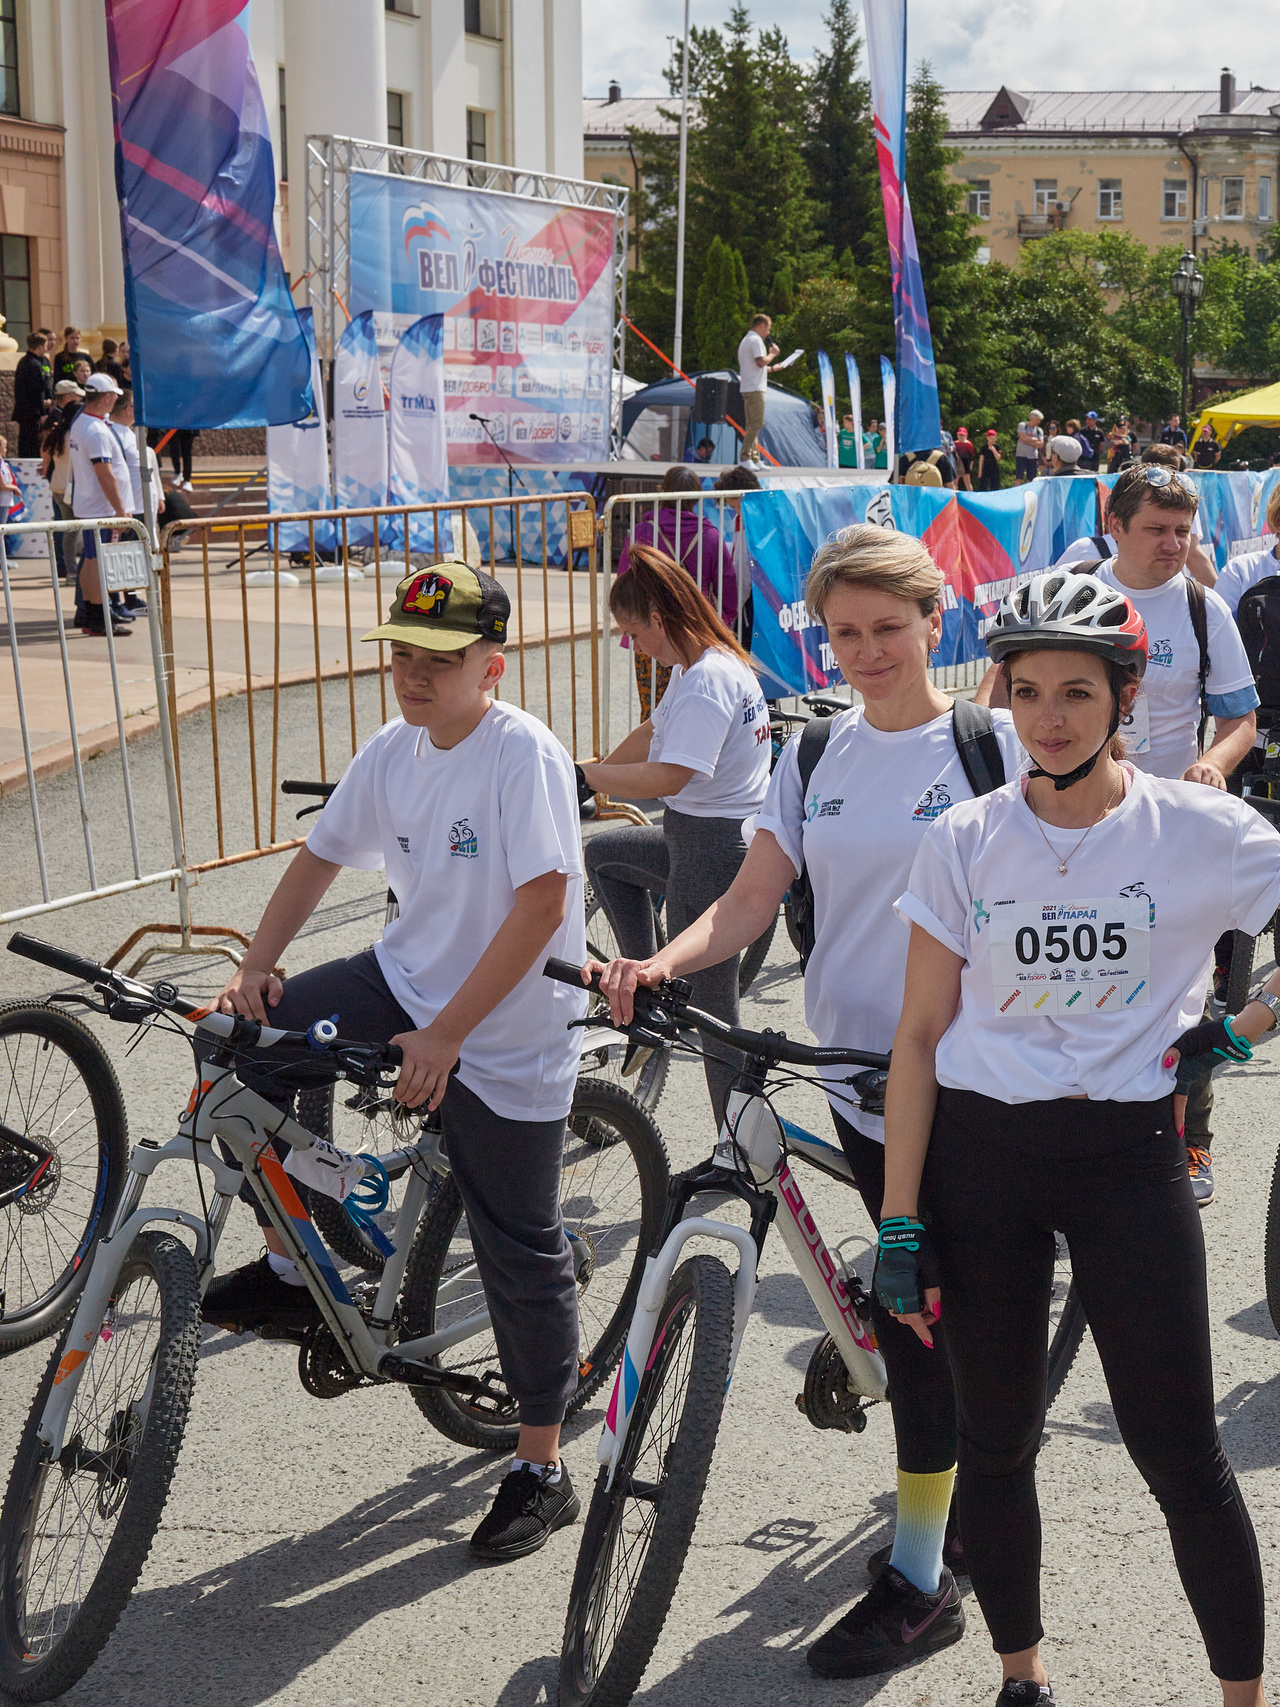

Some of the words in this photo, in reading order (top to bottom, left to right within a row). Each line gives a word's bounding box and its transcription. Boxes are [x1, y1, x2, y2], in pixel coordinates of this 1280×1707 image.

[1015, 923, 1127, 965] 0505
[699, 1012, 731, 1033] CONCEPT
[780, 1173, 866, 1341] FOCUS
